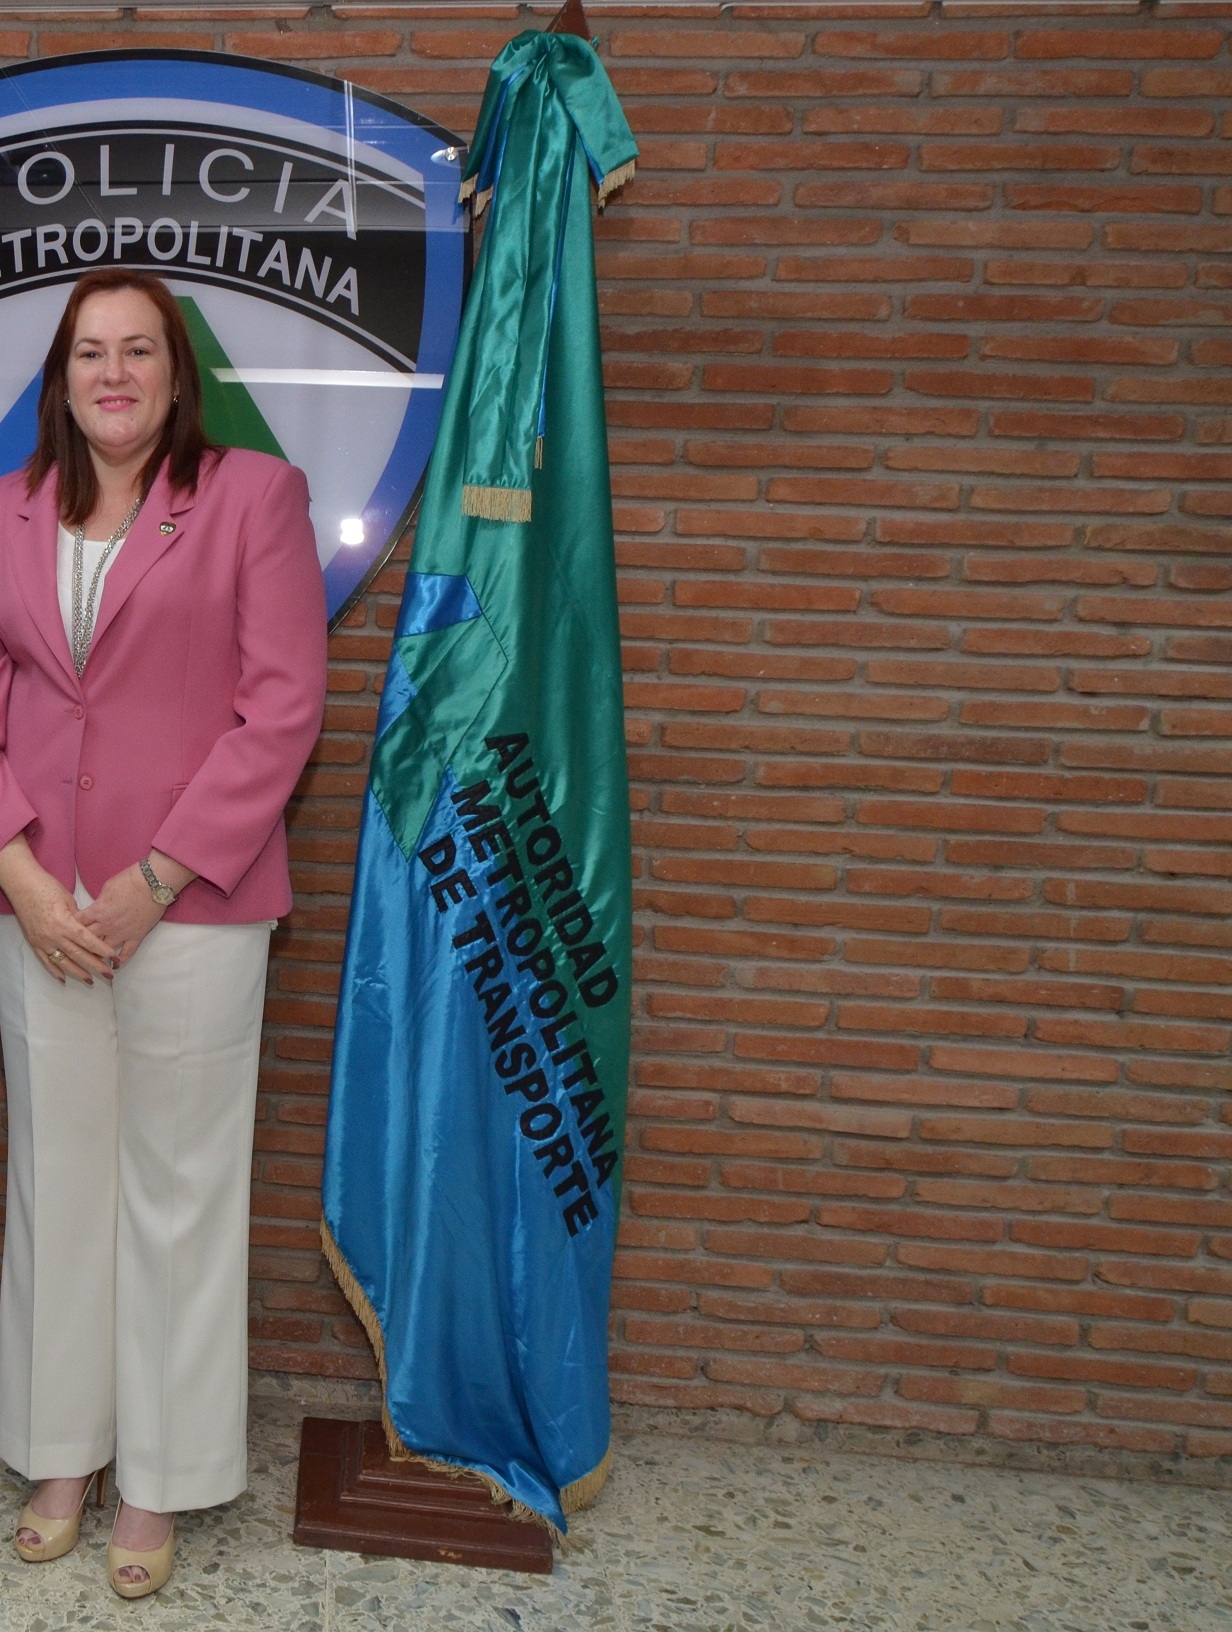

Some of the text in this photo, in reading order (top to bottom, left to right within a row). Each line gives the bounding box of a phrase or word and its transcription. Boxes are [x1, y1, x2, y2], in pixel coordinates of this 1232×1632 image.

[418, 832, 599, 1239] DE TRANSPORTE
[451, 779, 619, 1190] METROPOLITANA
[484, 731, 619, 1009] AUTORIDAD
